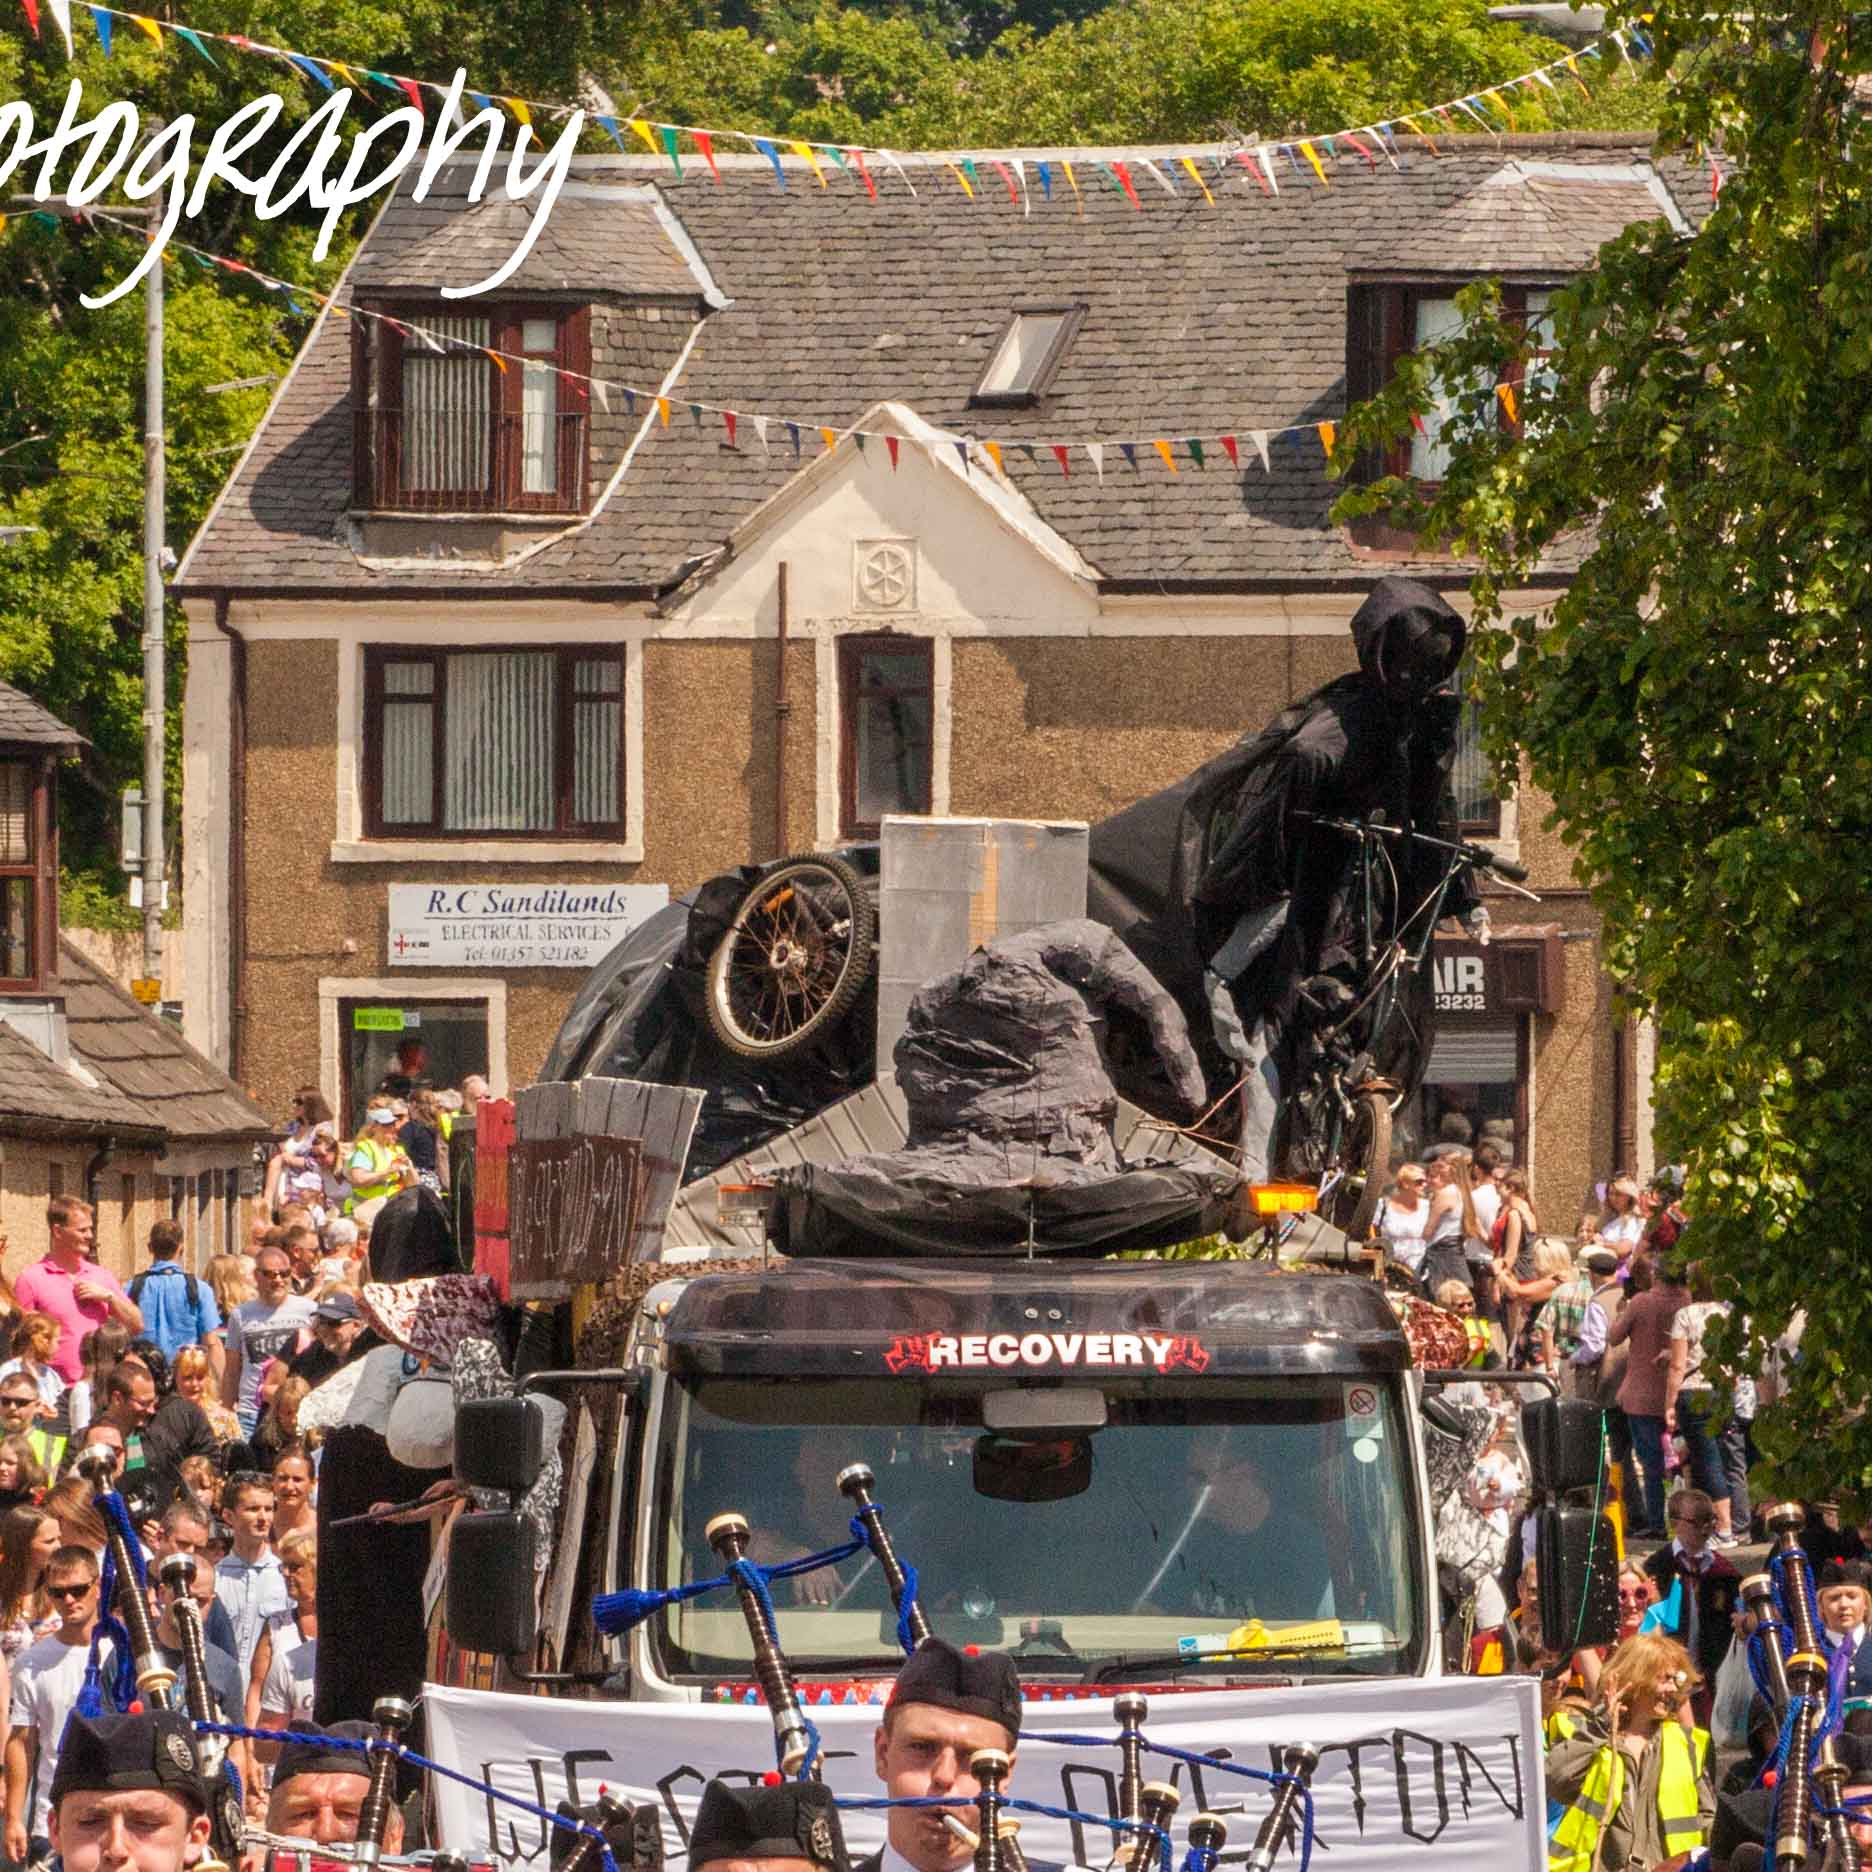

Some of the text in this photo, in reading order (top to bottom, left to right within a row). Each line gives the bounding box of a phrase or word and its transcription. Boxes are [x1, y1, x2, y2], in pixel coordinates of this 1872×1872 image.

[427, 890, 628, 913] R.C Sandilands
[441, 924, 532, 941] ELECTRICAL
[538, 923, 612, 941] SERVICES
[928, 1333, 1174, 1366] RECOVERY
